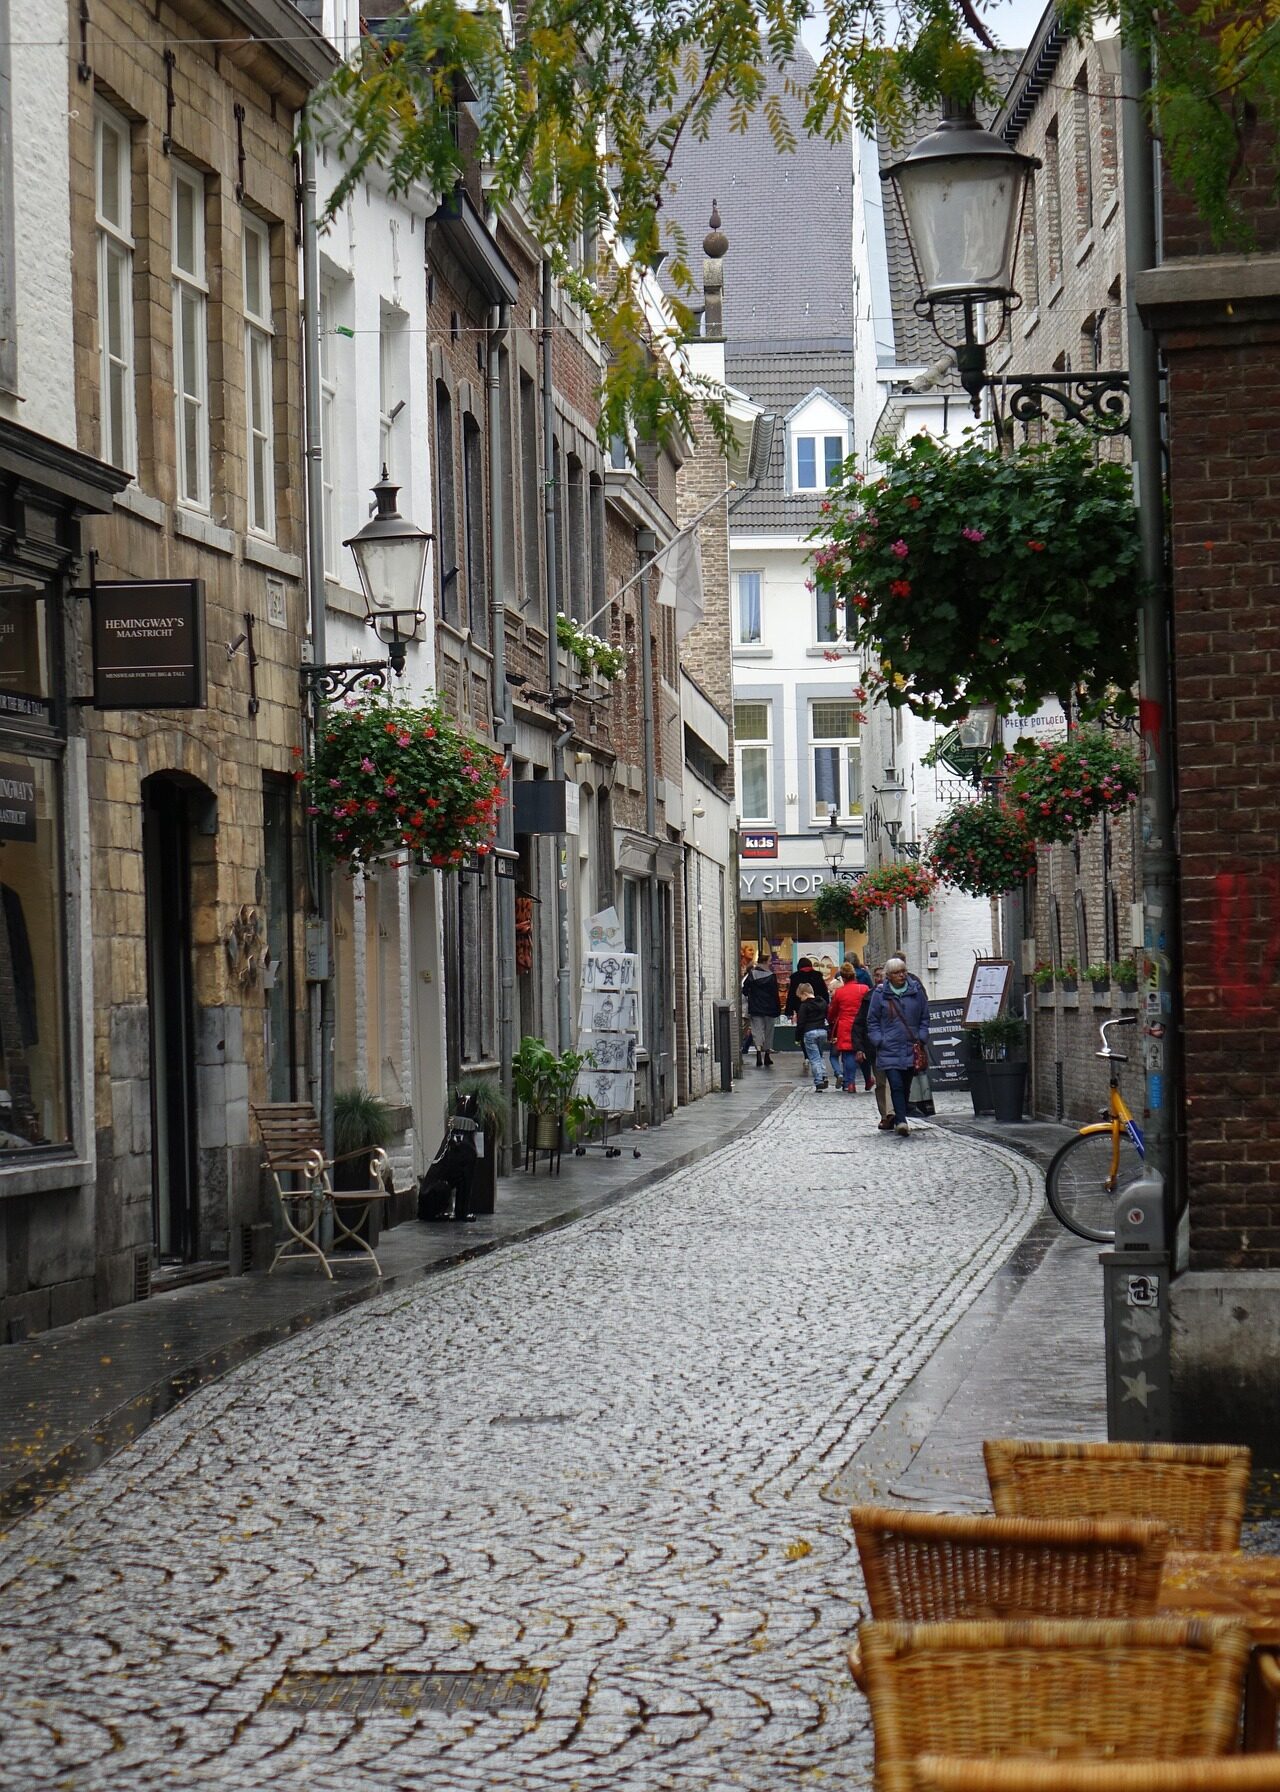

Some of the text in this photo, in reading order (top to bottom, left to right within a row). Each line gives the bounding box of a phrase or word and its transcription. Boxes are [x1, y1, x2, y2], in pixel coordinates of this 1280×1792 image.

[105, 617, 185, 629] HEMINGWAY'S
[116, 629, 174, 638] MAASTRICHT
[1031, 715, 1065, 727] POTLOED
[745, 837, 774, 848] kids
[740, 874, 824, 894] Y SHOP
